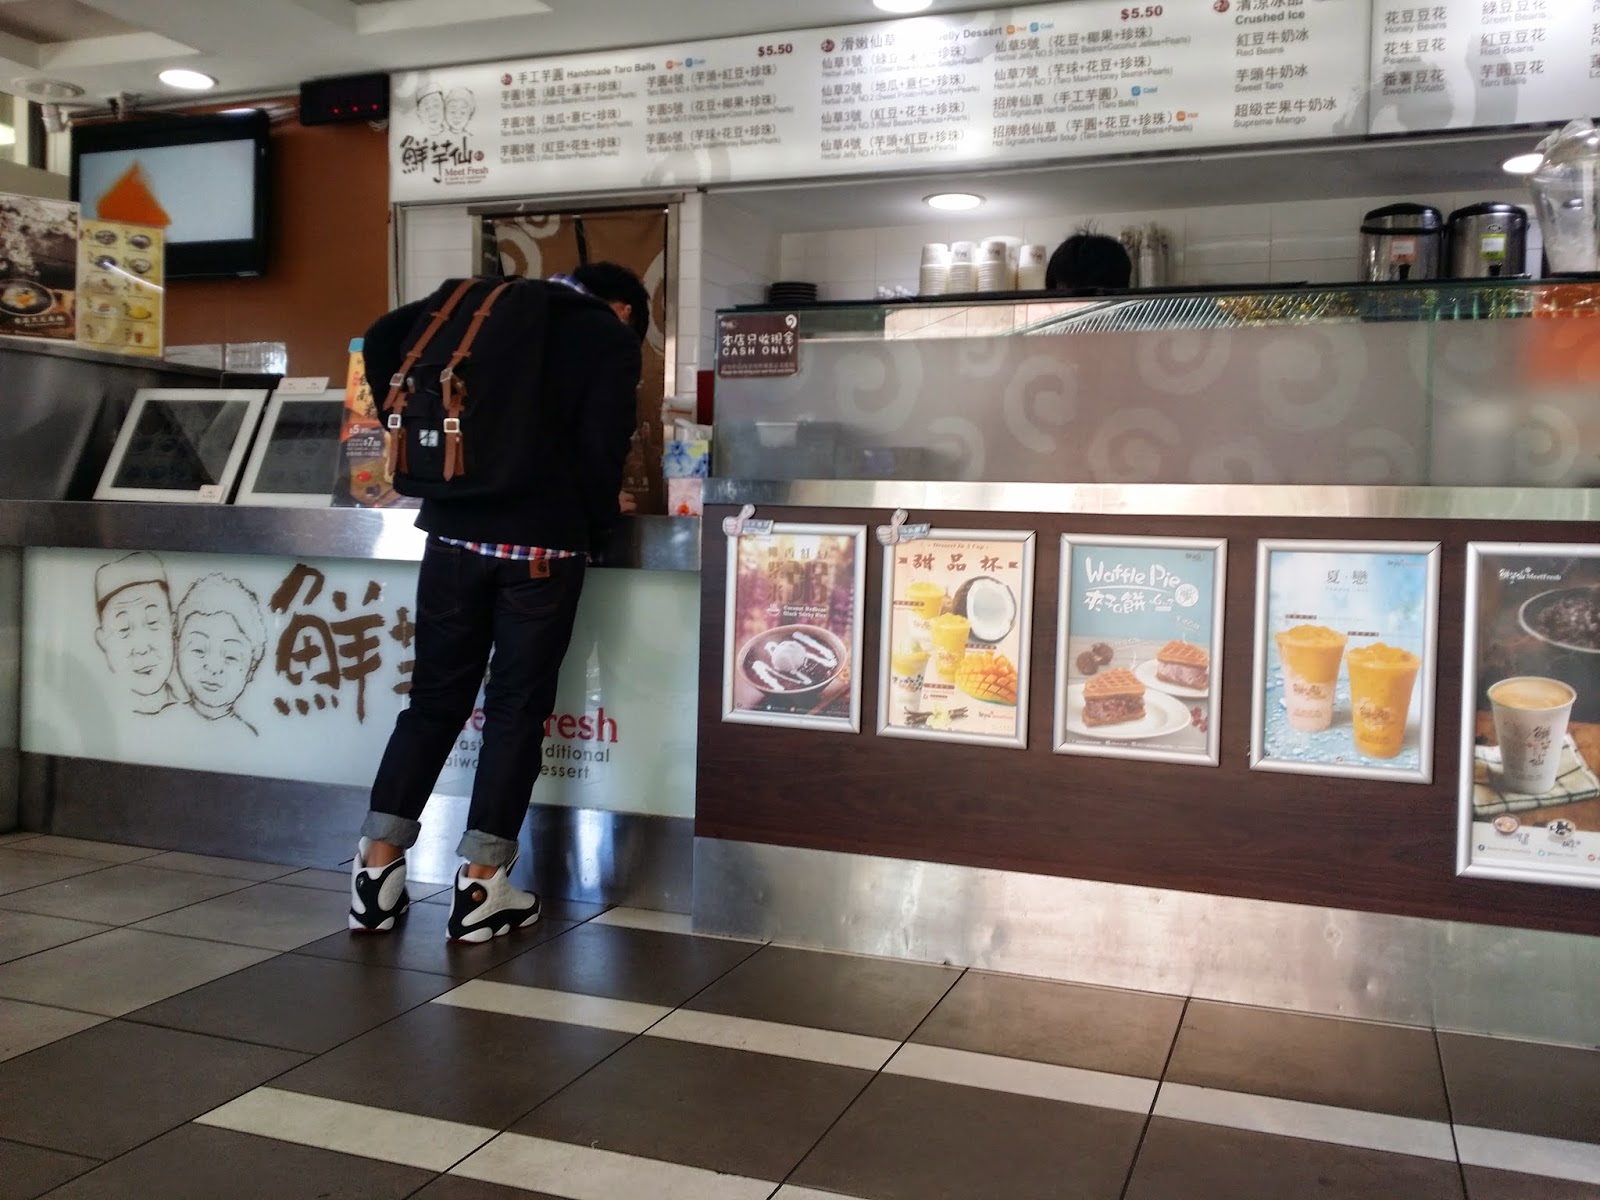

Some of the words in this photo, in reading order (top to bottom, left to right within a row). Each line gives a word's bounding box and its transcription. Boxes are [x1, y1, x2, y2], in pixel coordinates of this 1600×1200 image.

[1121, 5, 1163, 20] $5.50
[1235, 11, 1284, 25] Crushed
[1288, 10, 1305, 20] Ice
[1386, 6, 1447, 25] 花豆豆花
[1481, 14, 1512, 25] Green
[1515, 12, 1546, 22] Beans
[964, 27, 1002, 38] Dessert
[1384, 24, 1414, 34] Honey
[1418, 22, 1447, 31] Beans
[995, 37, 1039, 52] 仙草5號
[1237, 28, 1309, 47] 紅豆牛奶冰
[1481, 28, 1546, 47] 紅豆豆花
[758, 44, 793, 57] $5.50
[1236, 48, 1254, 56] Red
[1256, 46, 1284, 55] Beans
[1385, 37, 1446, 55] 花生豆花
[518, 68, 563, 85] 手工芋圓
[567, 68, 611, 78] Handmade
[635, 63, 655, 72] Balls
[994, 65, 1038, 80] 仙草7號
[1237, 64, 1308, 82] 芋頭牛奶冰
[1235, 84, 1262, 92] Sweet
[1265, 81, 1283, 90] Taro
[994, 93, 1043, 109] 招牌仙草
[1276, 116, 1306, 125] Mango
[400, 135, 472, 183] 鮮芋仙
[722, 331, 794, 346] 本店只收現金
[722, 347, 755, 355] CASH
[762, 345, 794, 355] ONLY
[913, 553, 1003, 572] 甜品杯
[1086, 557, 1146, 584] Waffle
[1150, 564, 1181, 588] Pie
[543, 707, 618, 743] resh
[542, 744, 610, 763] ditional
[540, 764, 590, 779] essert
